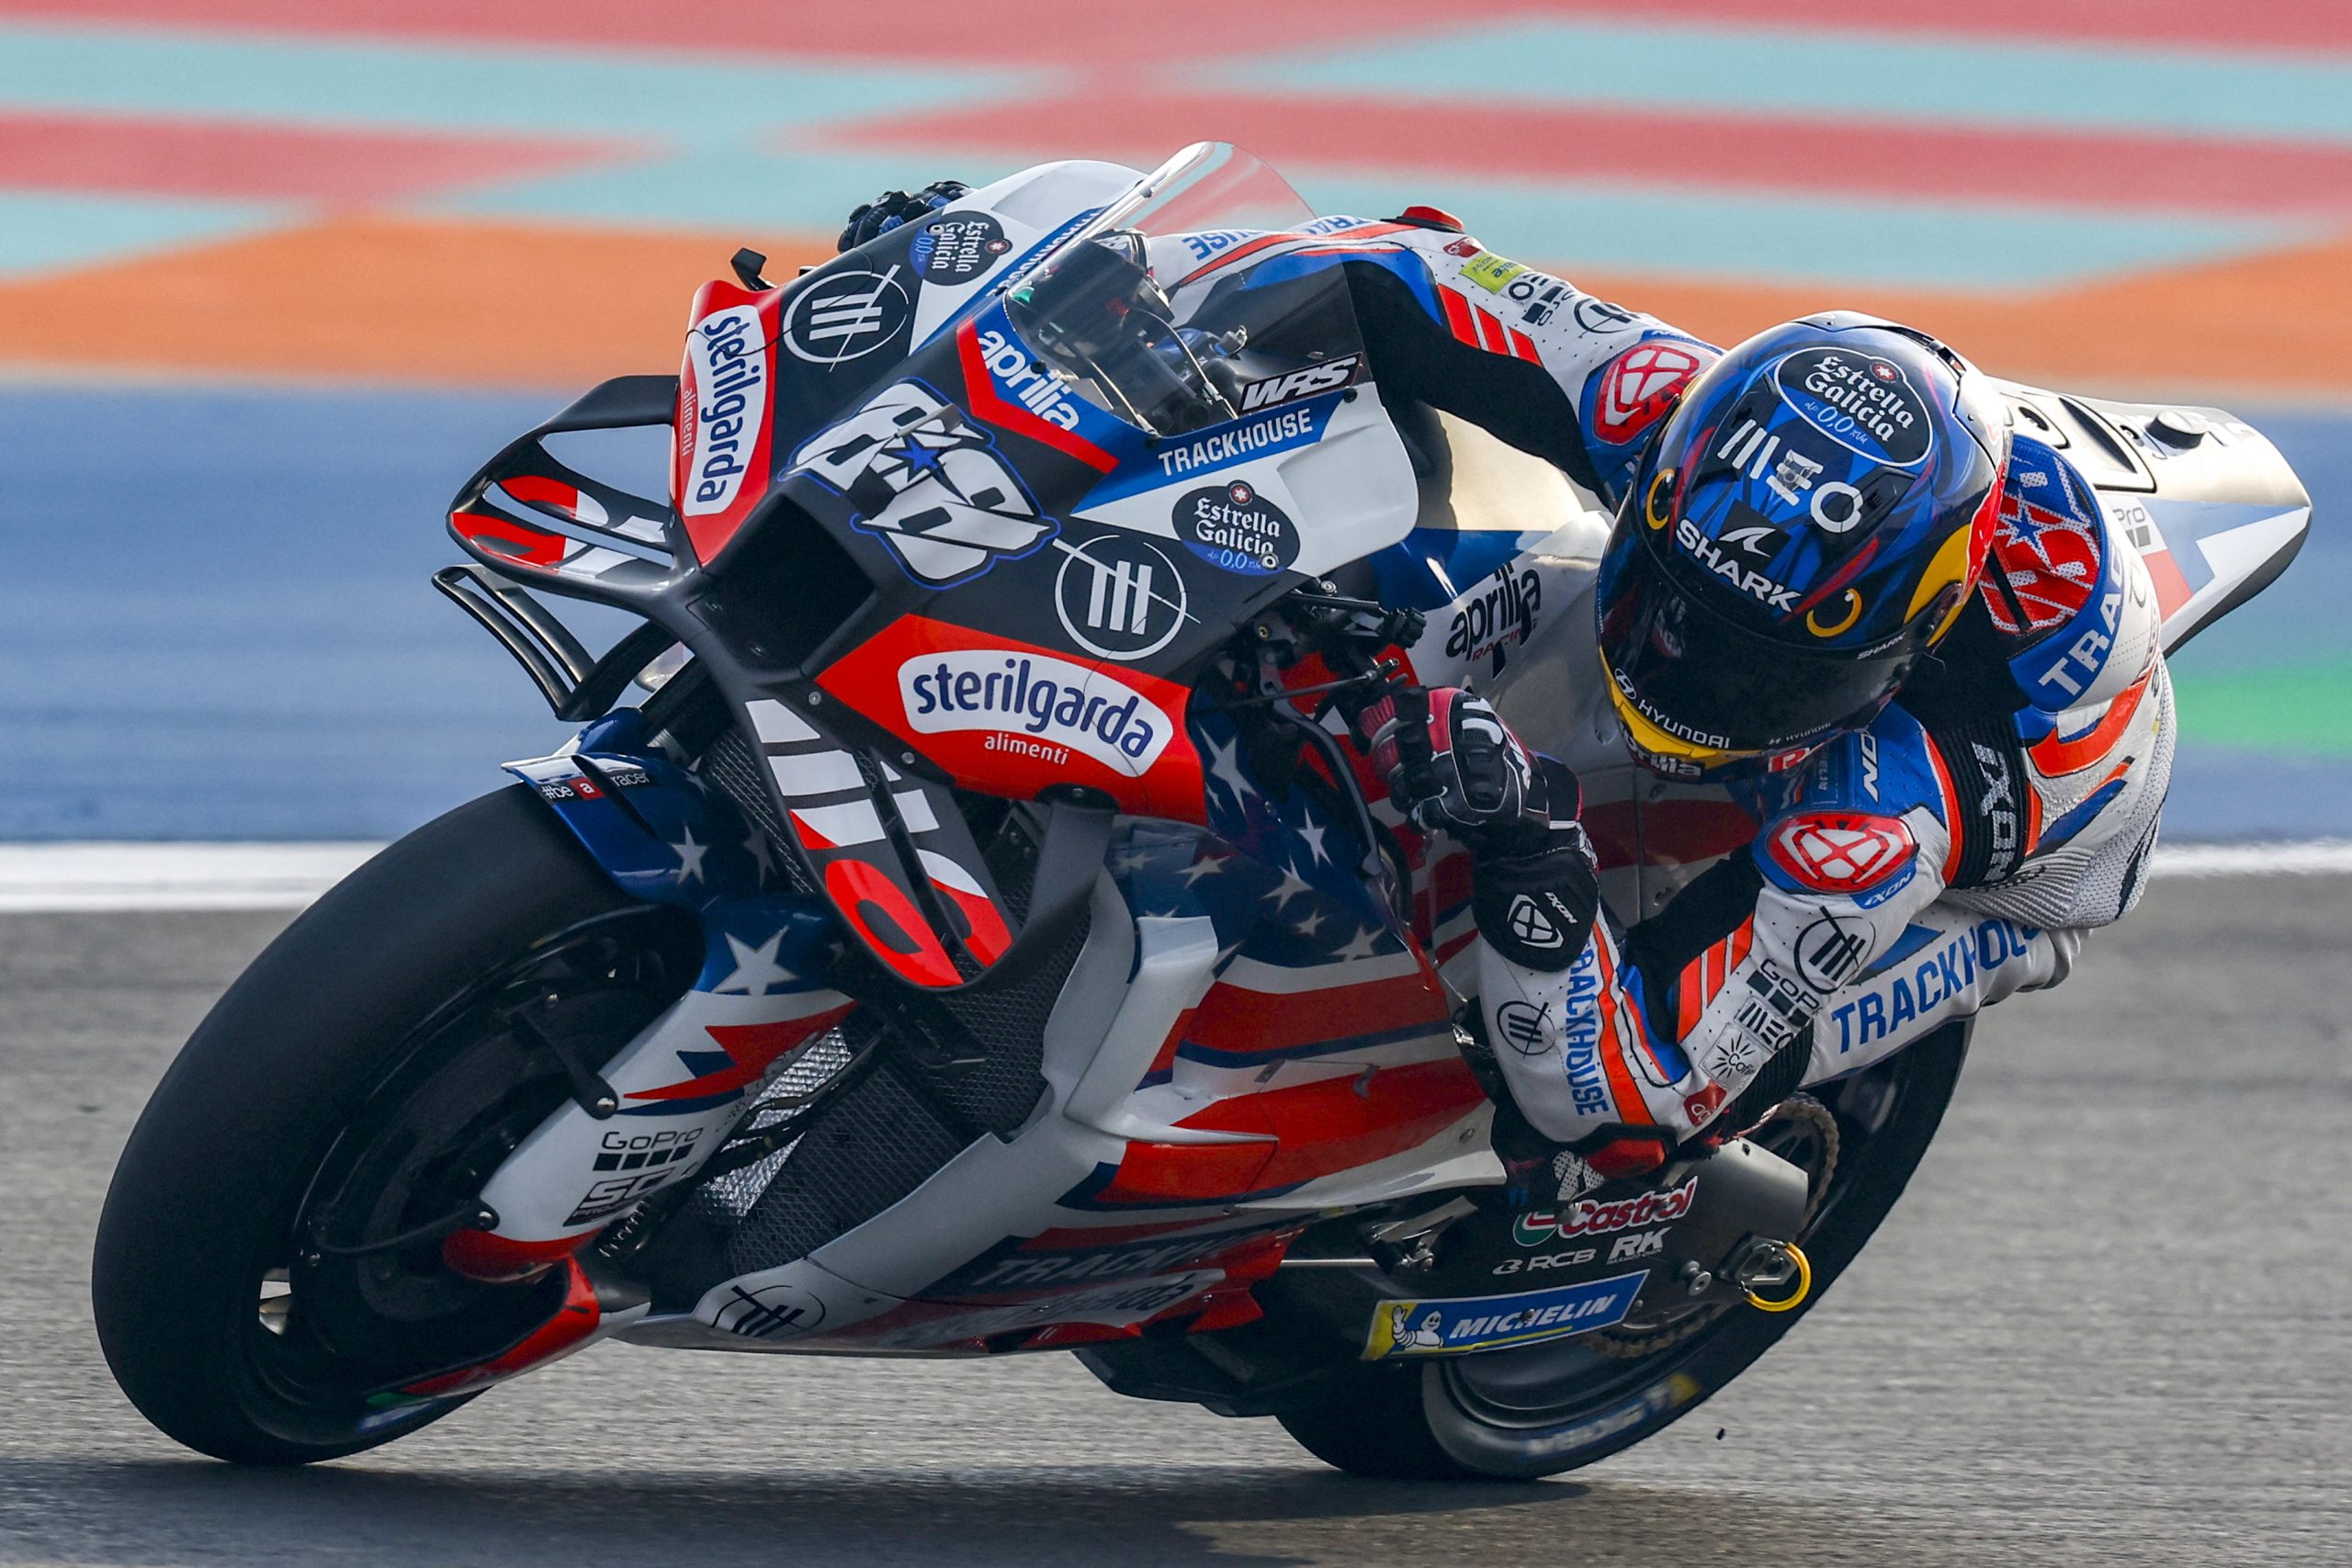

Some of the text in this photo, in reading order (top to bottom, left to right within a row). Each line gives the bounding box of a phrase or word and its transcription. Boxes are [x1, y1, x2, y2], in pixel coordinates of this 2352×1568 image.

[931, 222, 966, 270] Galicia
[956, 220, 990, 273] Estrella
[696, 316, 762, 503] sterilgarda
[978, 331, 1080, 432] aprilia
[1242, 355, 1358, 411] WRS
[1804, 371, 1894, 442] Galicia
[1813, 355, 1915, 429] Estrella
[682, 387, 696, 457] alimenti
[1159, 408, 1314, 477] TRACKHOUSE
[1194, 497, 1281, 538] Estrella
[1195, 519, 1274, 555] Galicia
[1676, 519, 1802, 614] SHARK
[1445, 561, 1542, 661] aprilia
[913, 658, 1154, 759] sterilgarda
[1638, 698, 1732, 750] HYUNDAI
[984, 732, 1070, 766] alimenti
[602, 1127, 704, 1150] GoPro
[1559, 1176, 1698, 1239] Castrol
[1609, 1226, 1672, 1258] RK
[1449, 1293, 1618, 1339] MICHELIN
